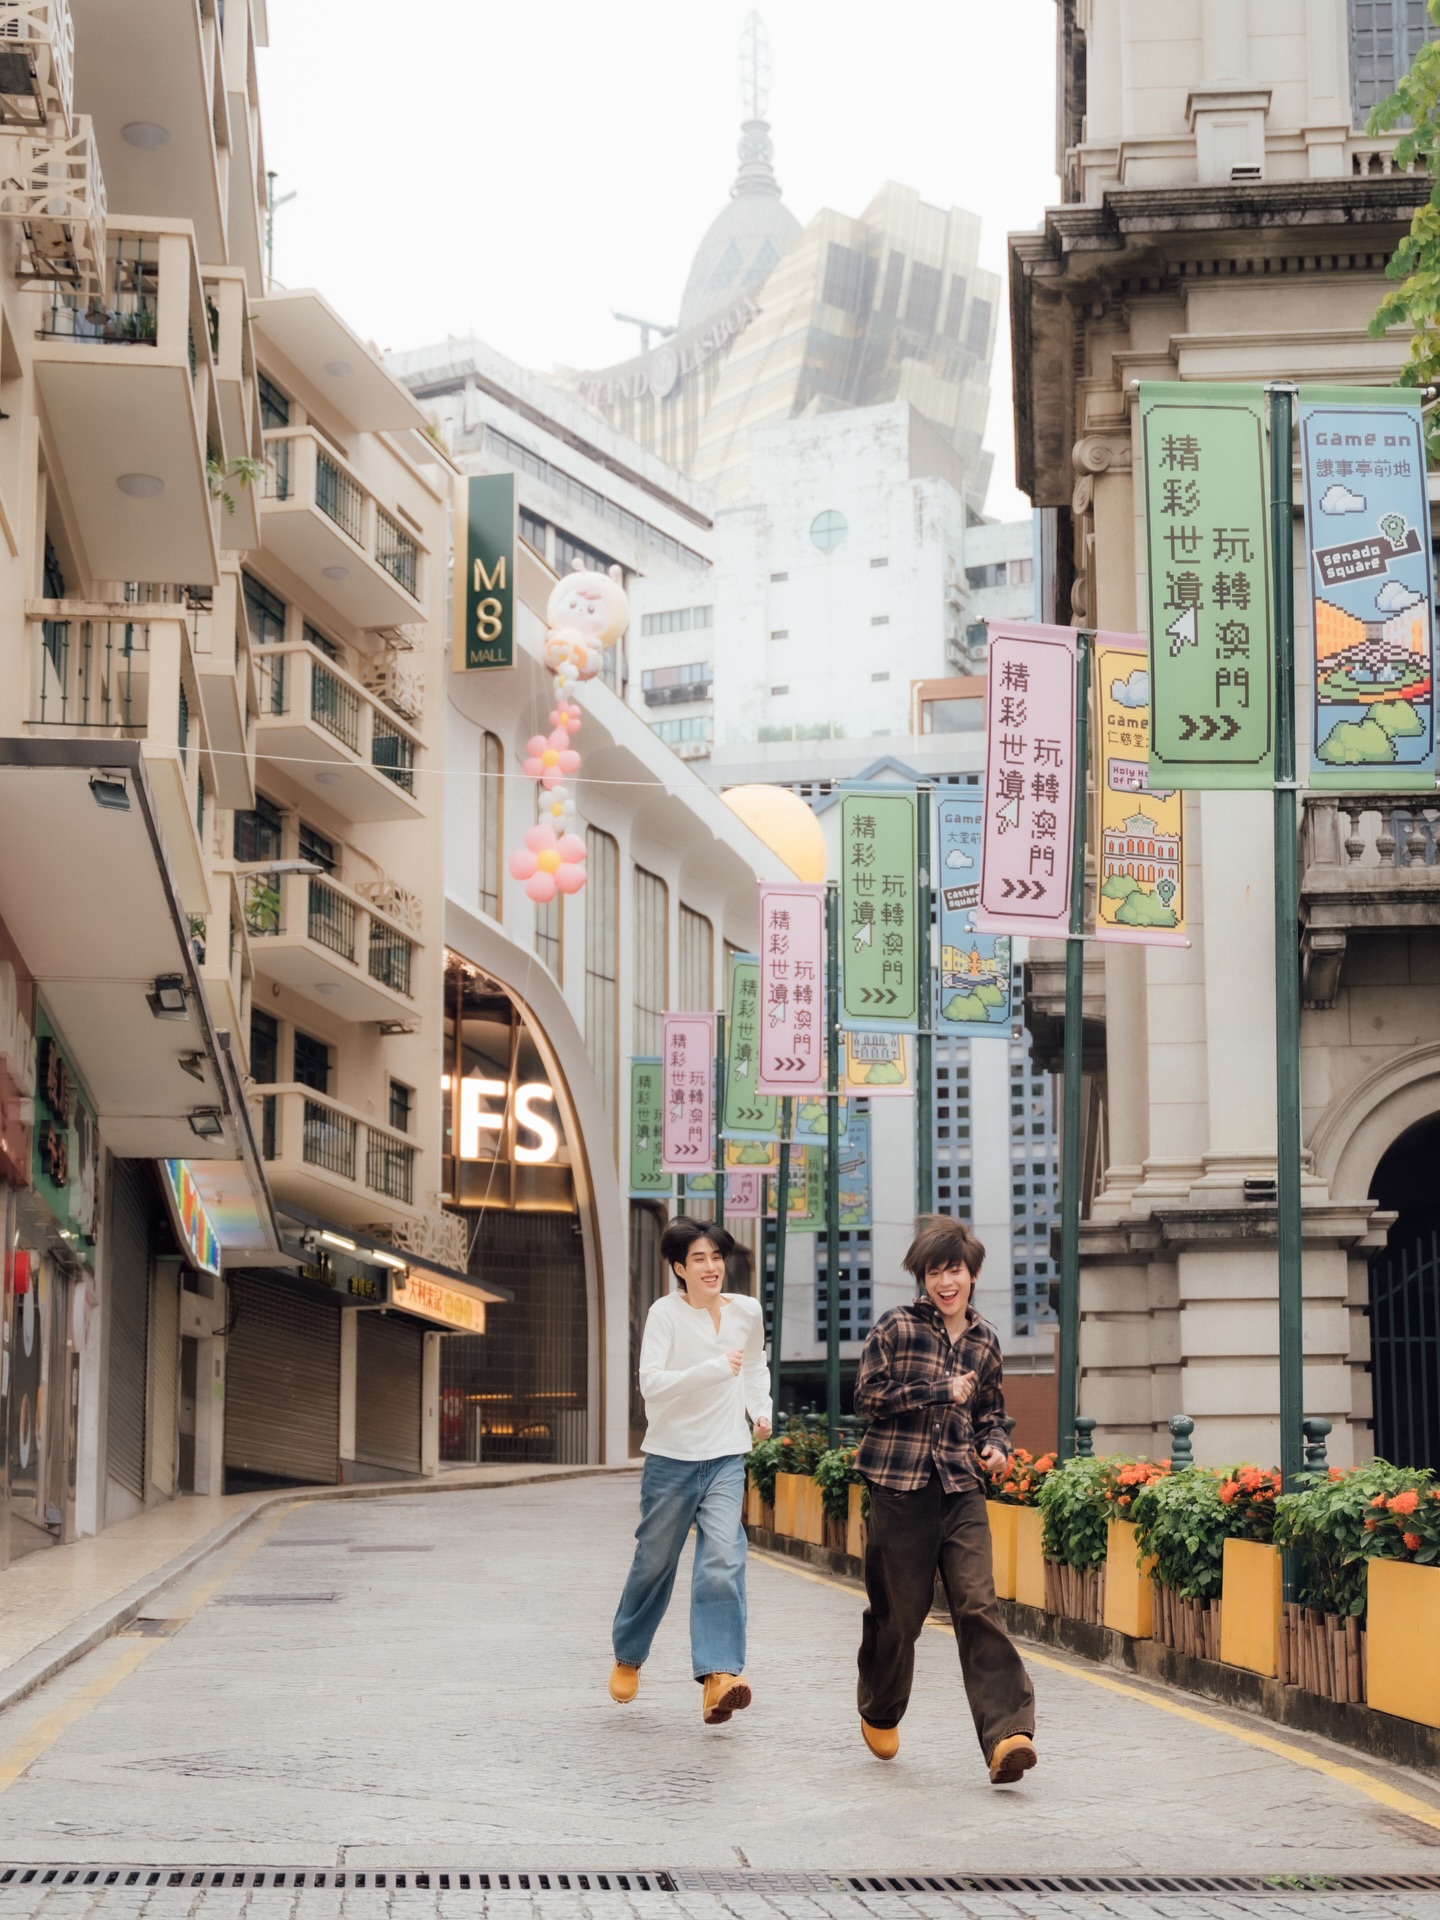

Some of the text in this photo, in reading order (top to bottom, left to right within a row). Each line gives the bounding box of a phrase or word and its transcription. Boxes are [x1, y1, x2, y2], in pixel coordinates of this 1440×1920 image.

[680, 297, 762, 375] LISBOA
[1316, 433, 1411, 447] Game on
[1316, 458, 1411, 477] 議事亭前地
[1158, 434, 1204, 610] 精彩世遺
[470, 648, 506, 663] MALL
[1212, 528, 1254, 708] 玩轉澳門
[995, 660, 1030, 800] 精彩世遺
[1107, 714, 1149, 729] Game
[1107, 730, 1149, 748] 仁慈堂
[1029, 738, 1063, 877] 玩轉澳門
[1113, 766, 1135, 778] Holy
[944, 814, 982, 824] Game
[850, 814, 877, 926] 精彩世遺
[768, 909, 791, 1004] 精彩世遺
[881, 875, 906, 985] 玩轉澳門
[736, 978, 758, 1062] 精彩世遺
[793, 960, 815, 1055] 玩轉澳門
[440, 1075, 558, 1162] FS
[688, 1071, 706, 1142] 玩轉澳門
